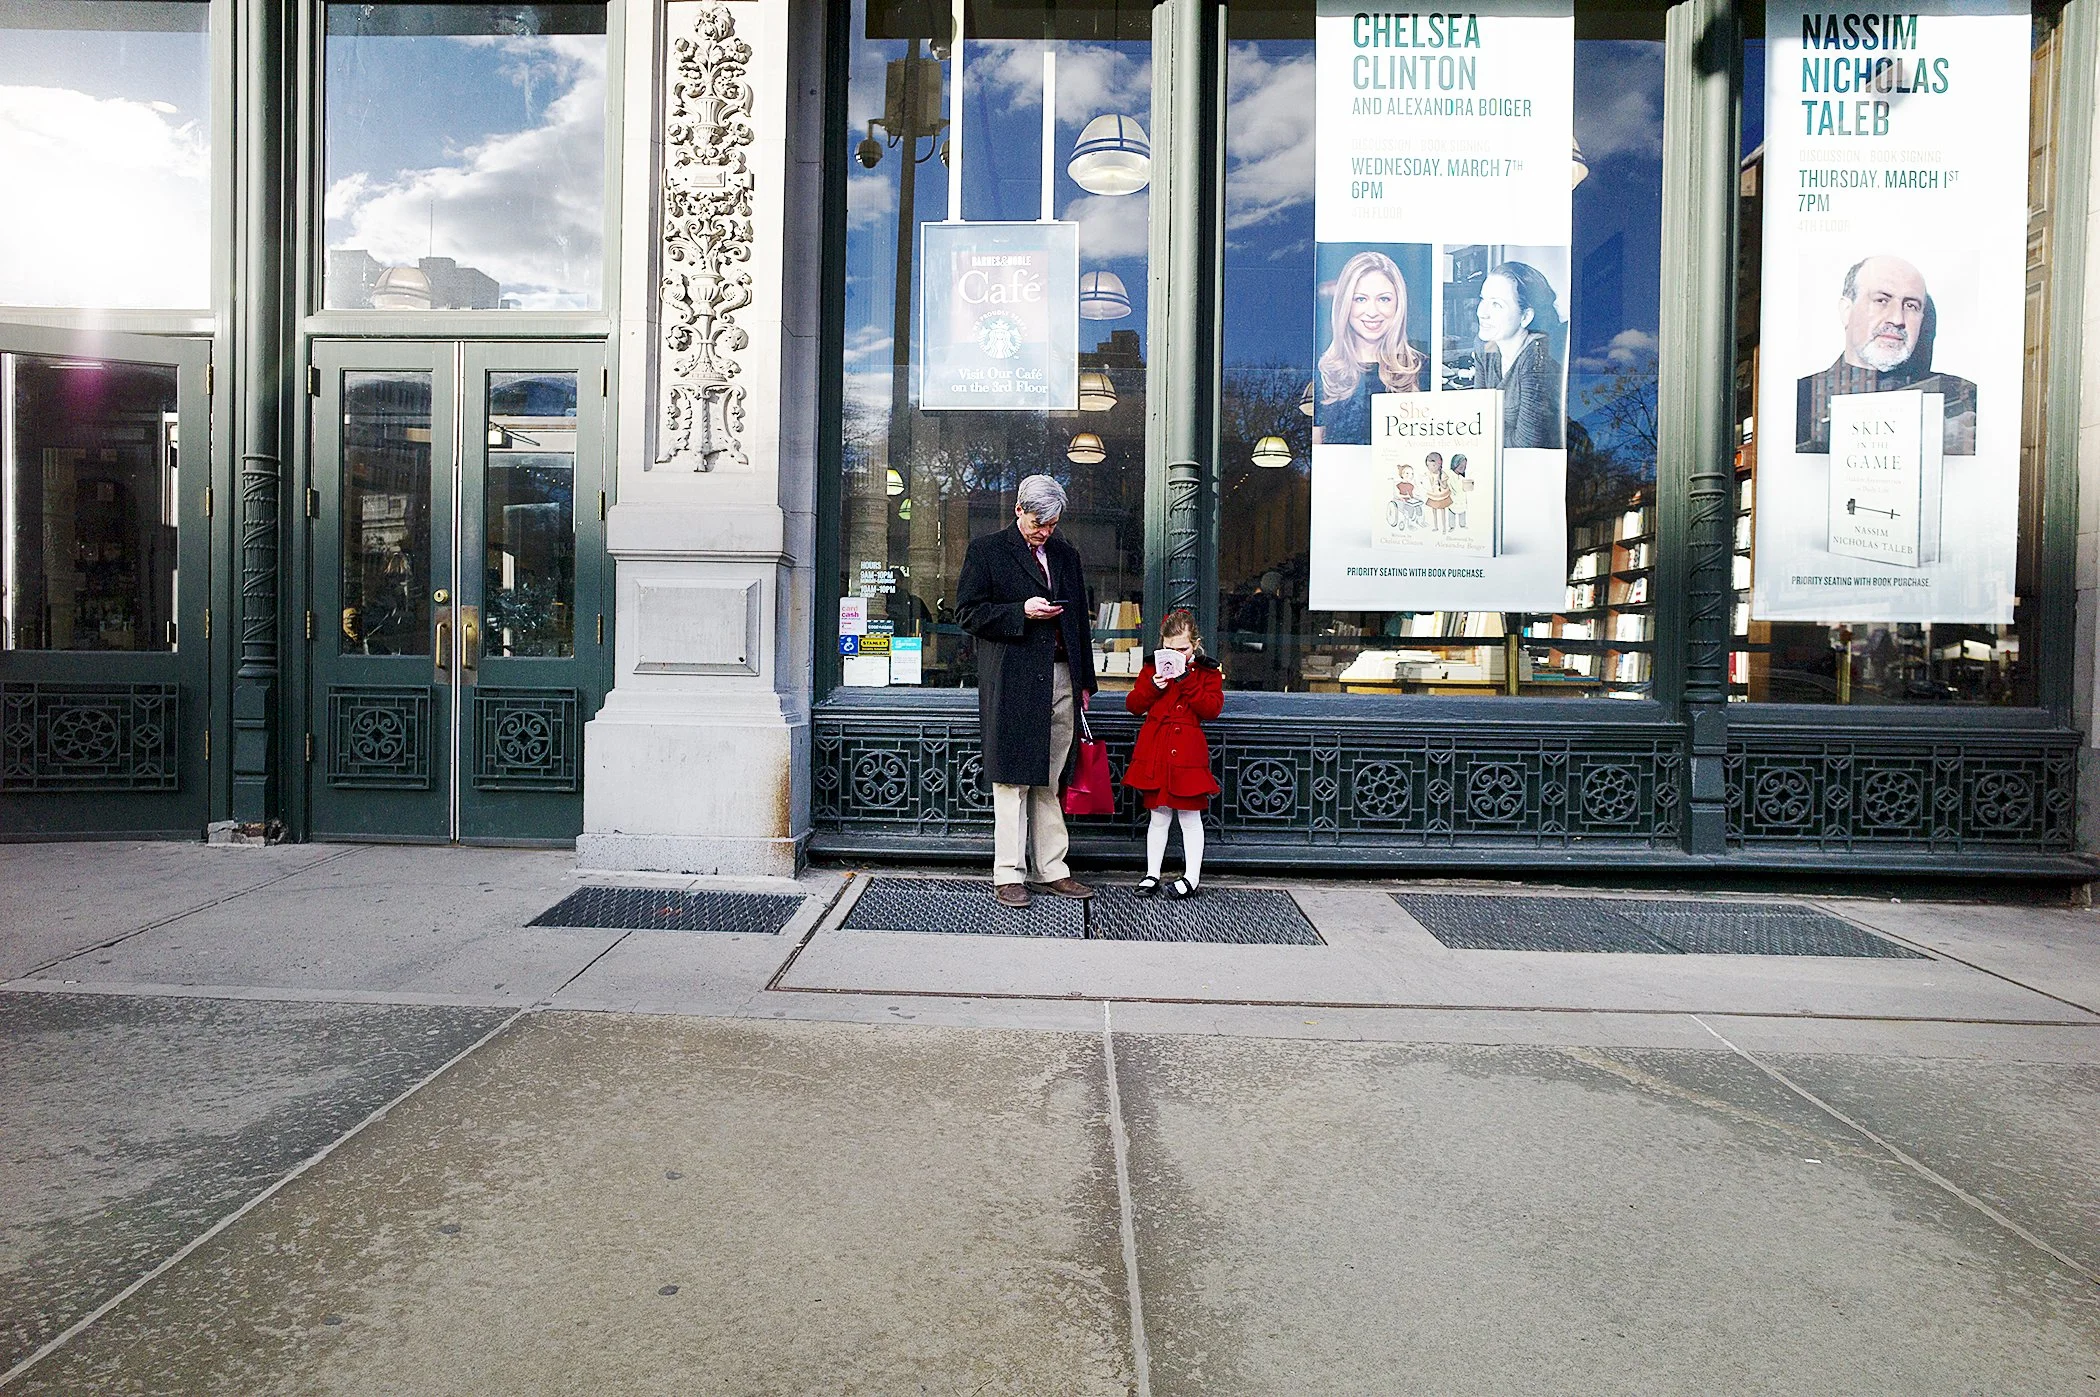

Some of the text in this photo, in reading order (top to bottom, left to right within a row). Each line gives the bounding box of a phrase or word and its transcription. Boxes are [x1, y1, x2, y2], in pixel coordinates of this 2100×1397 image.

[1354, 13, 1480, 48] CHELSEA
[1802, 14, 1917, 50] NASSIM
[1353, 55, 1476, 90] CLINTON
[1802, 58, 1949, 94] NICHOLAS
[1352, 98, 1532, 117] AND ALEXANDRA BOIGER
[1802, 101, 1889, 136] TALEB
[1800, 150, 1942, 163] DISCUSSION BOOK SIGNING
[1448, 159, 1500, 177] MARCH
[1504, 160, 1524, 177] 7TH
[1885, 171, 1937, 189] MARCH
[1944, 171, 1959, 189] 1ST
[1352, 181, 1383, 199] 6PM
[1798, 194, 1830, 212] 7PM
[959, 269, 1041, 304] Café
[958, 367, 1042, 380] Visit Our Café
[951, 380, 1048, 393] on the 3rd Floor
[1400, 402, 1430, 418] She
[1386, 412, 1482, 436] Persisted
[1852, 421, 1895, 435] SKIN
[1846, 456, 1902, 470] GAME
[1855, 526, 1888, 537] NASSIM
[1833, 535, 1913, 554] NICHOLAS TALEB
[861, 561, 881, 569] HOURS
[1347, 567, 1485, 578] PRIORITY SEATING WITH BOOK PURCHASE.
[860, 571, 893, 579] 9AM-10PM
[1792, 576, 1930, 587] PRIORITY SEATING WITH BOOK PURCHASE.
[860, 585, 896, 593] 10AM-10PM
